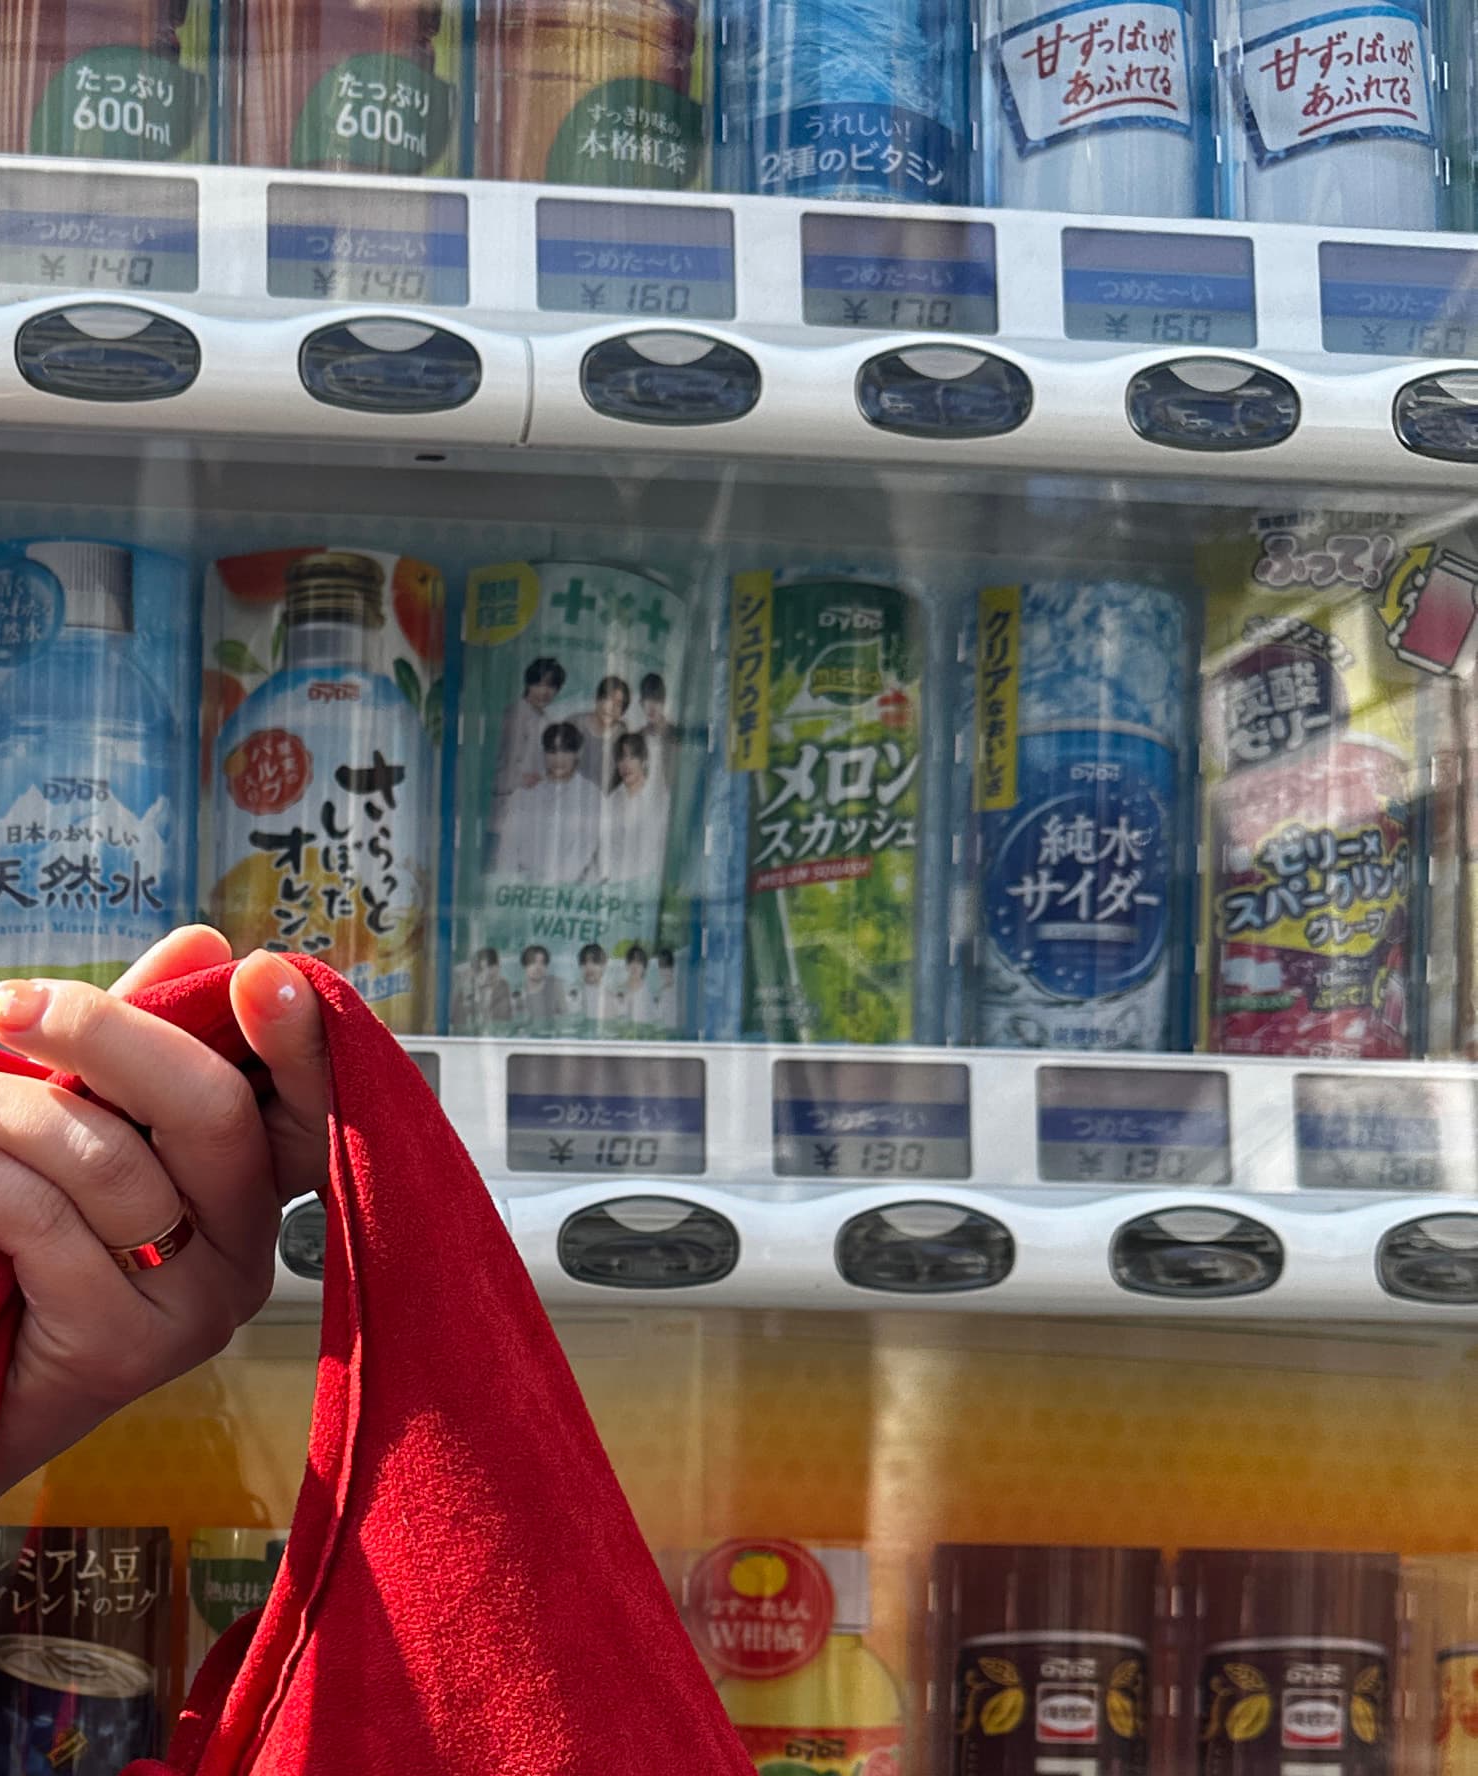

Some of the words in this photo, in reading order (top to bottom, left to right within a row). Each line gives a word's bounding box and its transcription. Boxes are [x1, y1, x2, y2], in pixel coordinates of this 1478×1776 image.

[75, 64, 174, 107] たっぷり
[336, 71, 431, 118] たっぷり
[1062, 62, 1172, 105] あふれてる
[1303, 74, 1411, 118] あふれてる
[73, 100, 171, 148] 600ml
[335, 103, 426, 158] 600ml
[586, 101, 682, 139] すっきり味の
[578, 133, 688, 174] 本格紅茶
[760, 142, 945, 188] 2種のビタミン
[43, 778, 109, 802] DyDo
[757, 742, 920, 820] メロン
[6, 823, 139, 847] 日本のおいしい
[335, 750, 405, 935] さらっと
[754, 810, 917, 865] スカッシュ
[1039, 814, 1144, 865] 純水
[322, 800, 363, 921] しぼった
[496, 885, 571, 912] GREEN
[1007, 872, 1160, 922] サイダー
[1222, 852, 1409, 932] スパークリング
